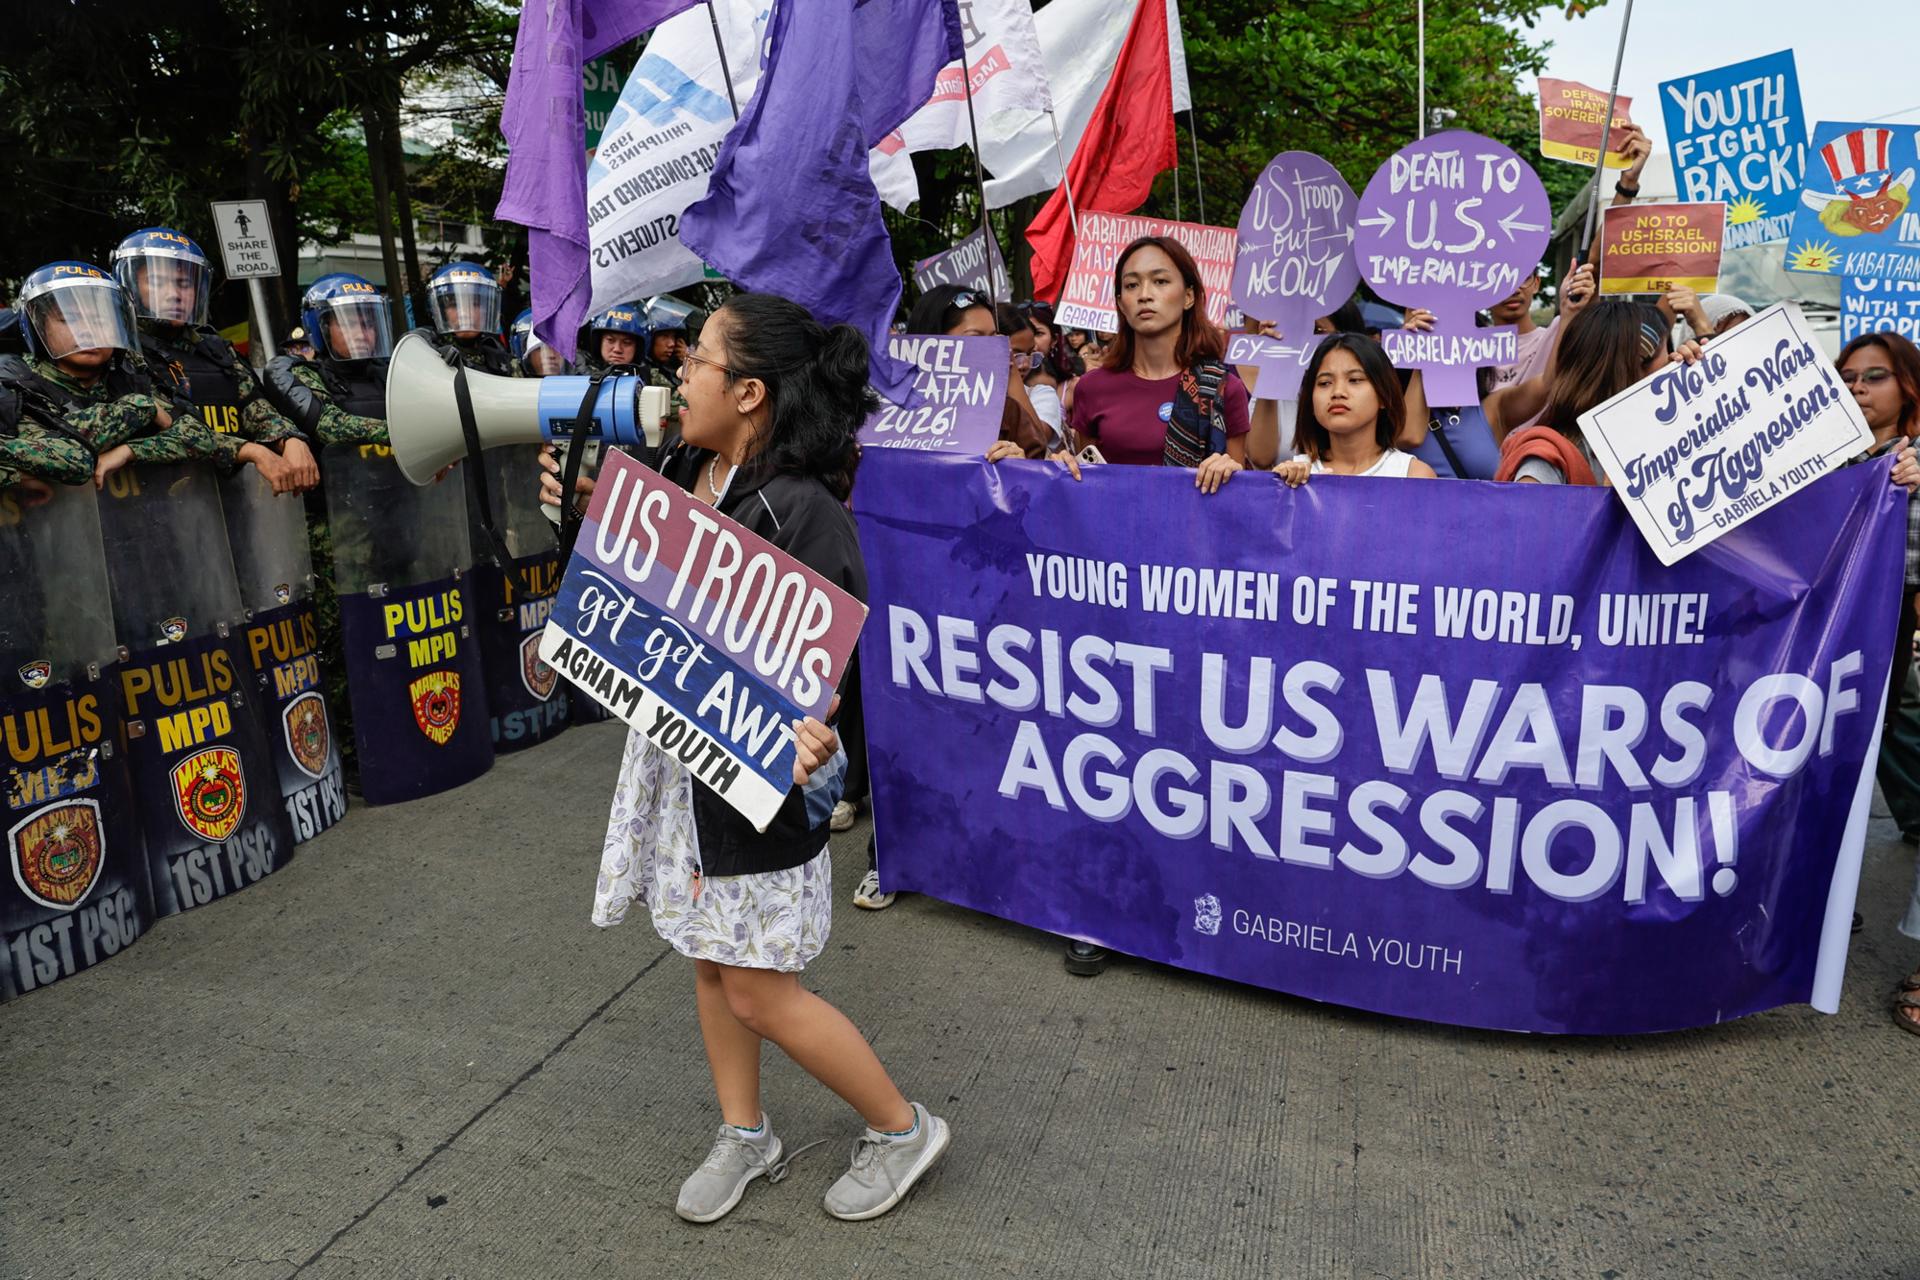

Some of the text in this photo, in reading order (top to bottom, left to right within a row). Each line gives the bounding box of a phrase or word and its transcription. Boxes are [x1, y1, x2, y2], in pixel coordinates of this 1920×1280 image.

[1562, 89, 1609, 104] DEFEN
[1667, 74, 1785, 134] YOUTH
[1575, 150, 1597, 162] LFS
[1675, 116, 1790, 168] FIGHT
[1390, 151, 1522, 195] DEATH TO
[1683, 142, 1806, 202] BACK!
[149, 231, 190, 246] PULIS
[227, 240, 269, 251] SHARE
[1406, 197, 1497, 253] U.S.
[1607, 241, 1717, 255] AGGRESSION!
[1620, 228, 1705, 242] US-ISRAEL
[1636, 215, 1689, 228] NO TO
[55, 265, 102, 279] PULIS
[236, 262, 269, 273] ROAD
[239, 251, 262, 261] THE
[1368, 255, 1520, 292] IMPERIALISM
[1647, 280, 1673, 291] LFS
[1845, 295, 1899, 317] WITH
[1062, 305, 1118, 332] GABRIEL
[1384, 330, 1518, 364] GABRIELA YOUTH
[1650, 353, 1728, 424] No to
[874, 407, 957, 437] 2026!
[1625, 338, 1816, 498] Imperialist Wars
[1667, 477, 1695, 543] of
[1712, 453, 1828, 528] GABRIELA YOUTH
[383, 588, 463, 639] PULIS
[595, 468, 832, 707] US TROOPS
[1026, 553, 1709, 651] YOUNG WOMEN OF THE WORLD, UNITE!
[247, 611, 318, 670] PULIS
[408, 632, 456, 669] MPD
[577, 571, 650, 646] get
[638, 616, 712, 693] get
[121, 649, 233, 715] PULIS
[273, 655, 319, 698] MPD
[888, 603, 1864, 791] RESIST US WARS OF
[0, 694, 102, 763] ULIS
[157, 700, 232, 754] MPD
[552, 637, 742, 795] AGHAM YOUTH
[286, 785, 323, 845] 1ST
[998, 720, 1739, 906] AGGRESSION!
[171, 823, 275, 911] 1ST PSC
[10, 887, 138, 991] 1ST PSC
[1233, 908, 1464, 975] GABRIELA YOUTH
